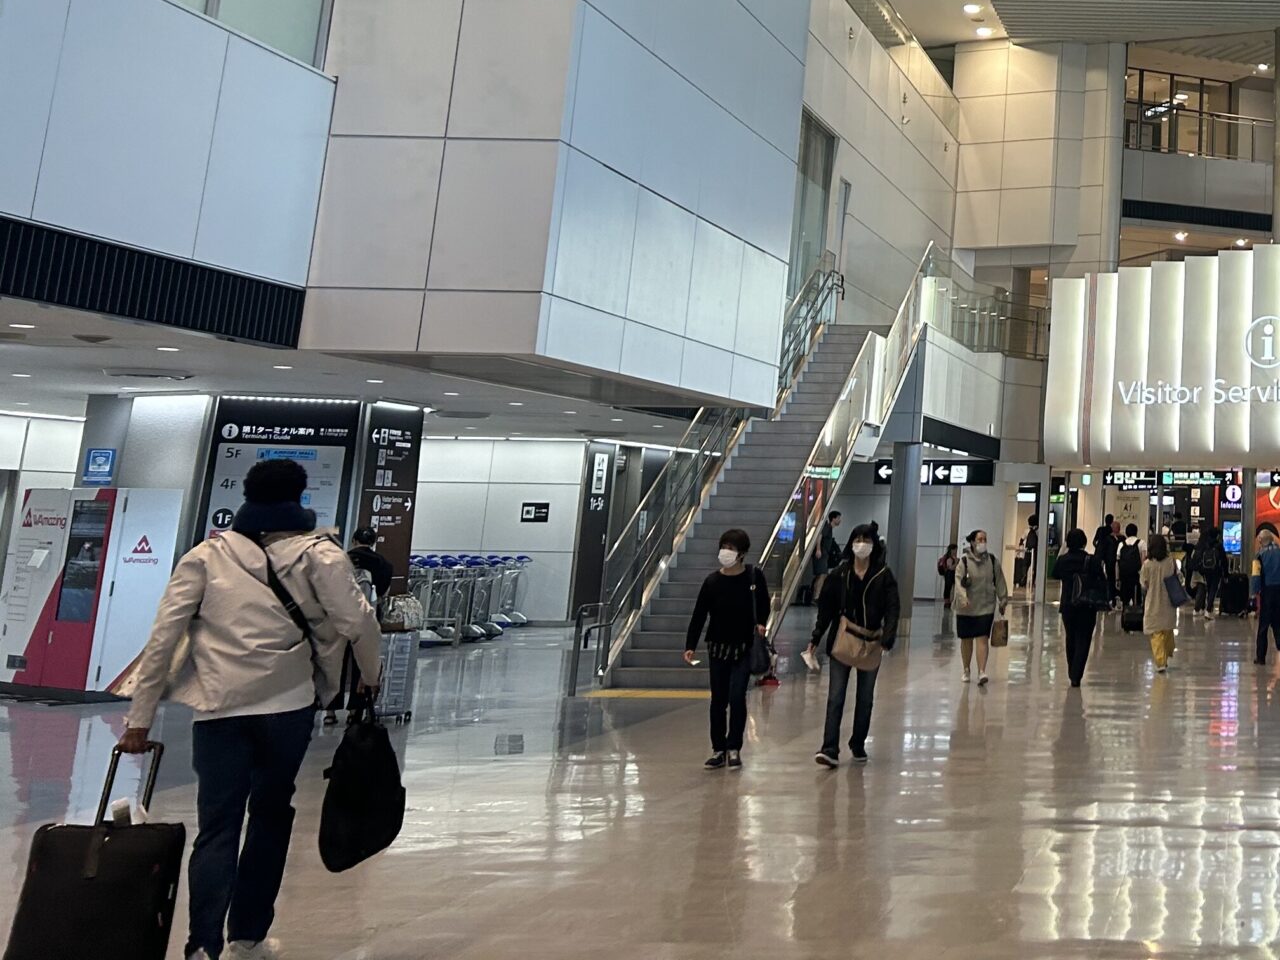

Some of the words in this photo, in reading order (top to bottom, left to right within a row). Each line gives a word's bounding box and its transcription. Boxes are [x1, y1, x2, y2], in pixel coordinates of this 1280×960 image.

[1118, 380, 1202, 405] Visitor
[242, 425, 315, 436] 第1ターミナル案内
[225, 447, 242, 459] 5F
[220, 478, 237, 490] 4F
[33, 514, 67, 529] WAmazing
[216, 512, 233, 525] 1F
